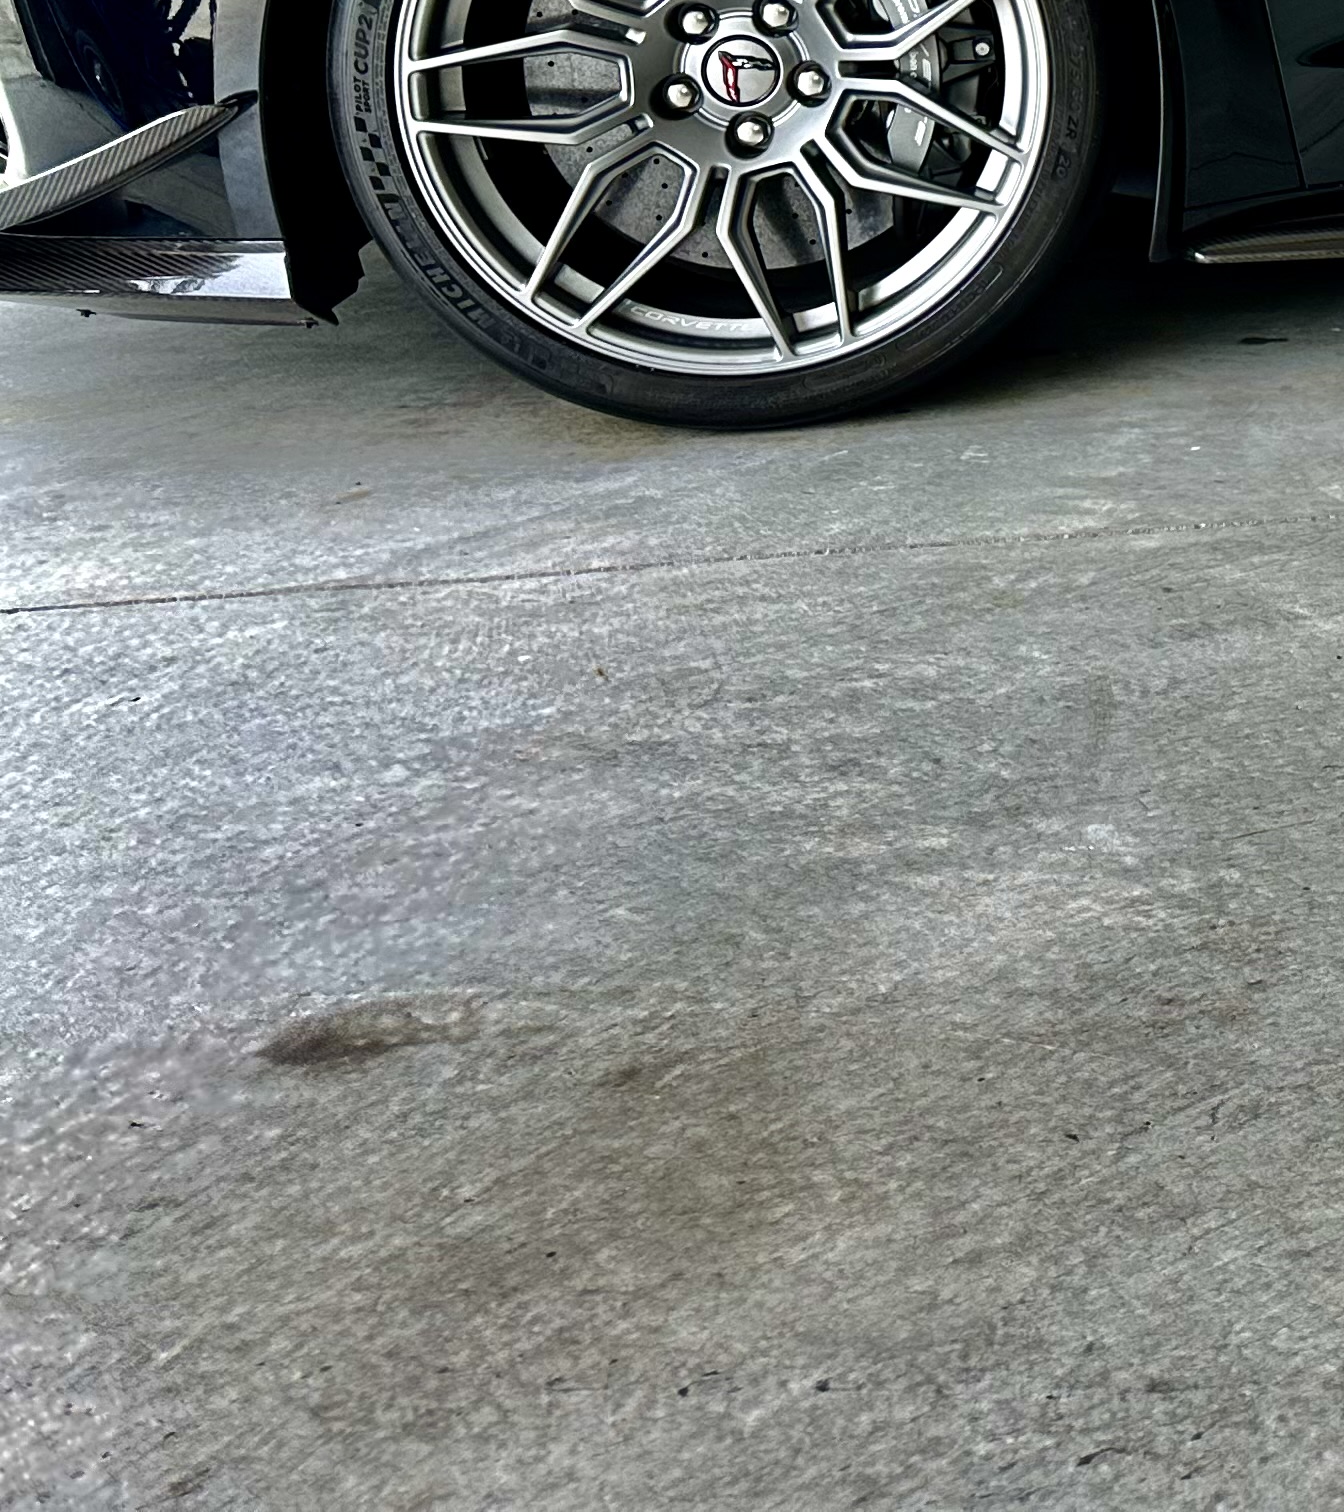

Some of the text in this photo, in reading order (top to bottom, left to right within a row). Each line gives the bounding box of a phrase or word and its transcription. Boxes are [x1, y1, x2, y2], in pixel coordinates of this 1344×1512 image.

[354, 75, 363, 112] PILOT
[364, 81, 372, 114] SPORT
[1056, 153, 1072, 178] 20
[384, 202, 498, 329] MICHELIN
[630, 306, 755, 331] CORVETTE
